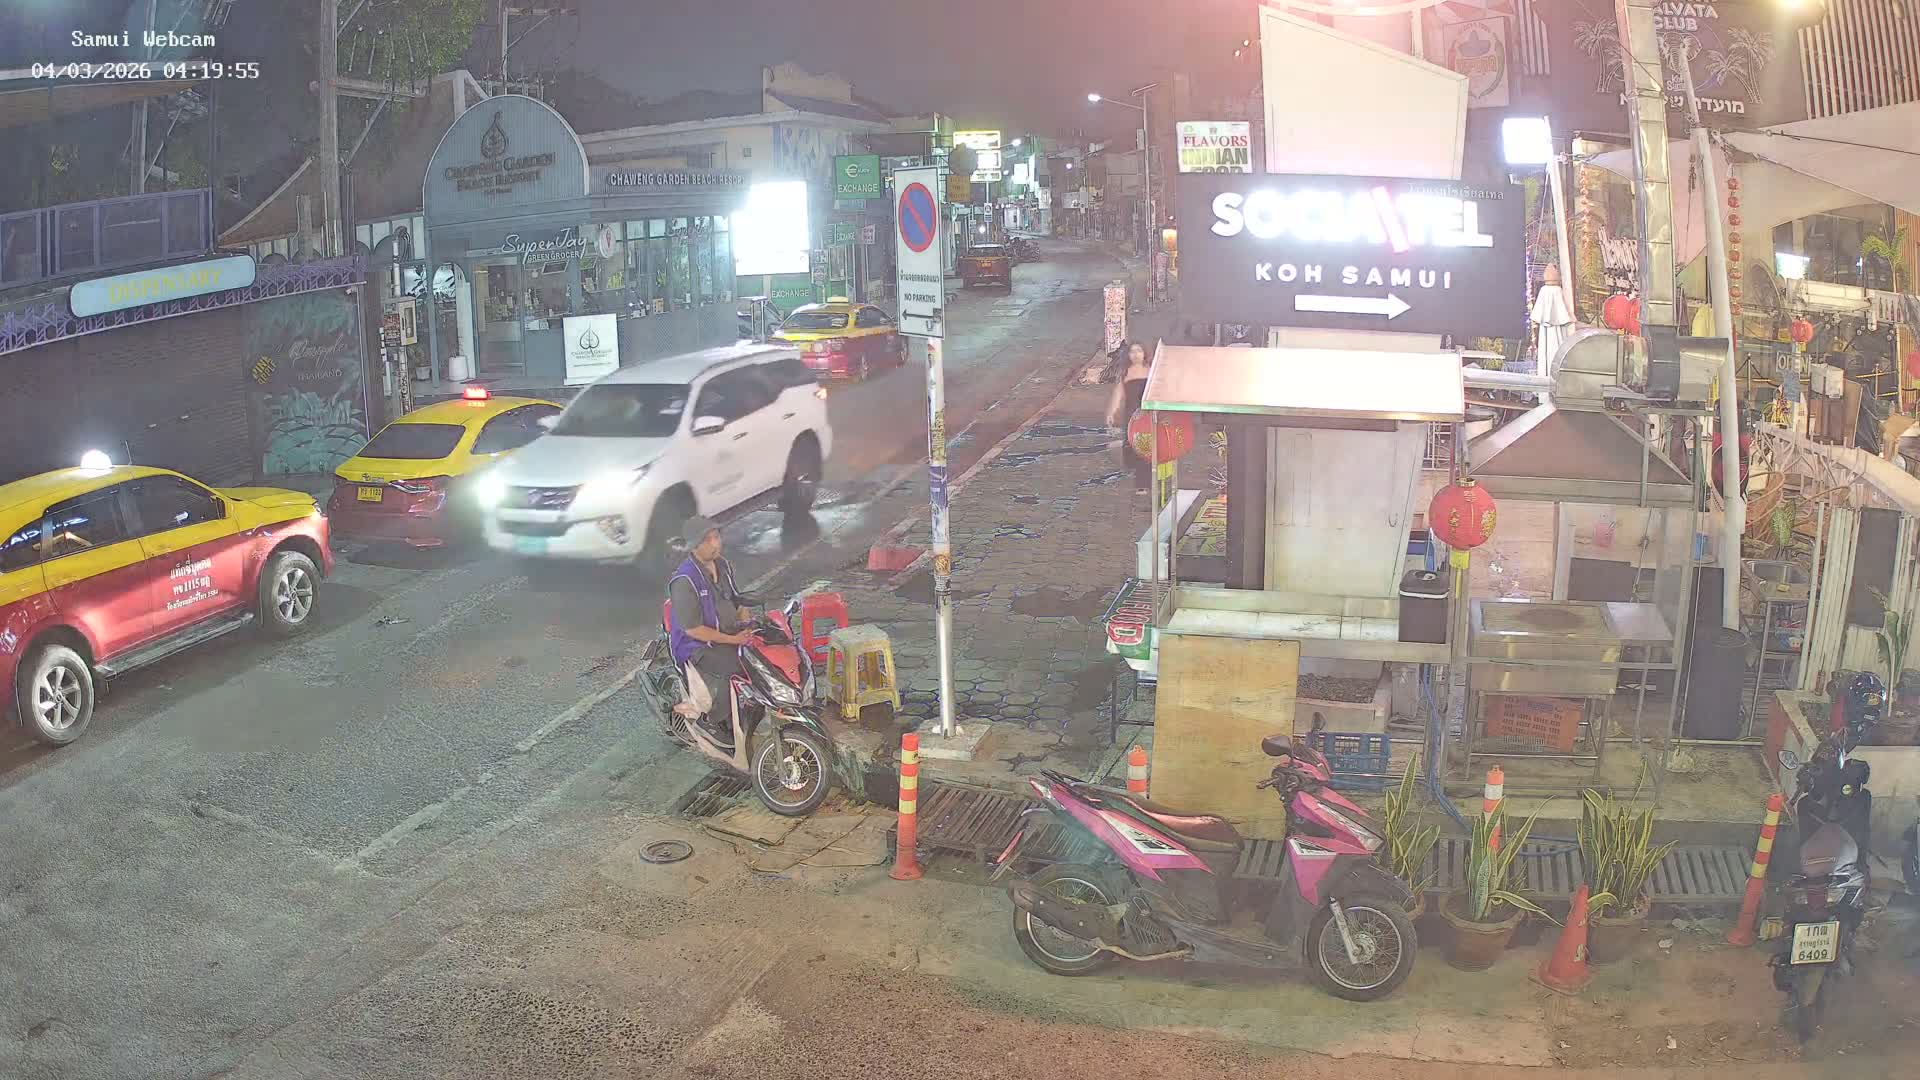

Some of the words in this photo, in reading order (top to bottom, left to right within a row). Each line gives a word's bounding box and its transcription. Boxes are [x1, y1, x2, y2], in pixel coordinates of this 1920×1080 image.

[1653, 16, 1698, 31] CLUB
[1183, 135, 1248, 147] FLAVORS
[1182, 148, 1248, 165] INDIAN
[610, 173, 654, 186] CHAWENG
[656, 173, 690, 185] GARDEN
[692, 174, 717, 185] BEACH
[837, 183, 878, 193] EXCHANGE
[1255, 262, 1322, 283] KOH
[1342, 264, 1451, 289] SAMUI
[109, 268, 223, 304] DISPENSARY
[771, 289, 809, 298] EXCHANGE
[904, 292, 912, 301] NO
[912, 293, 936, 304] PARKING
[1798, 949, 1828, 961] 6409
